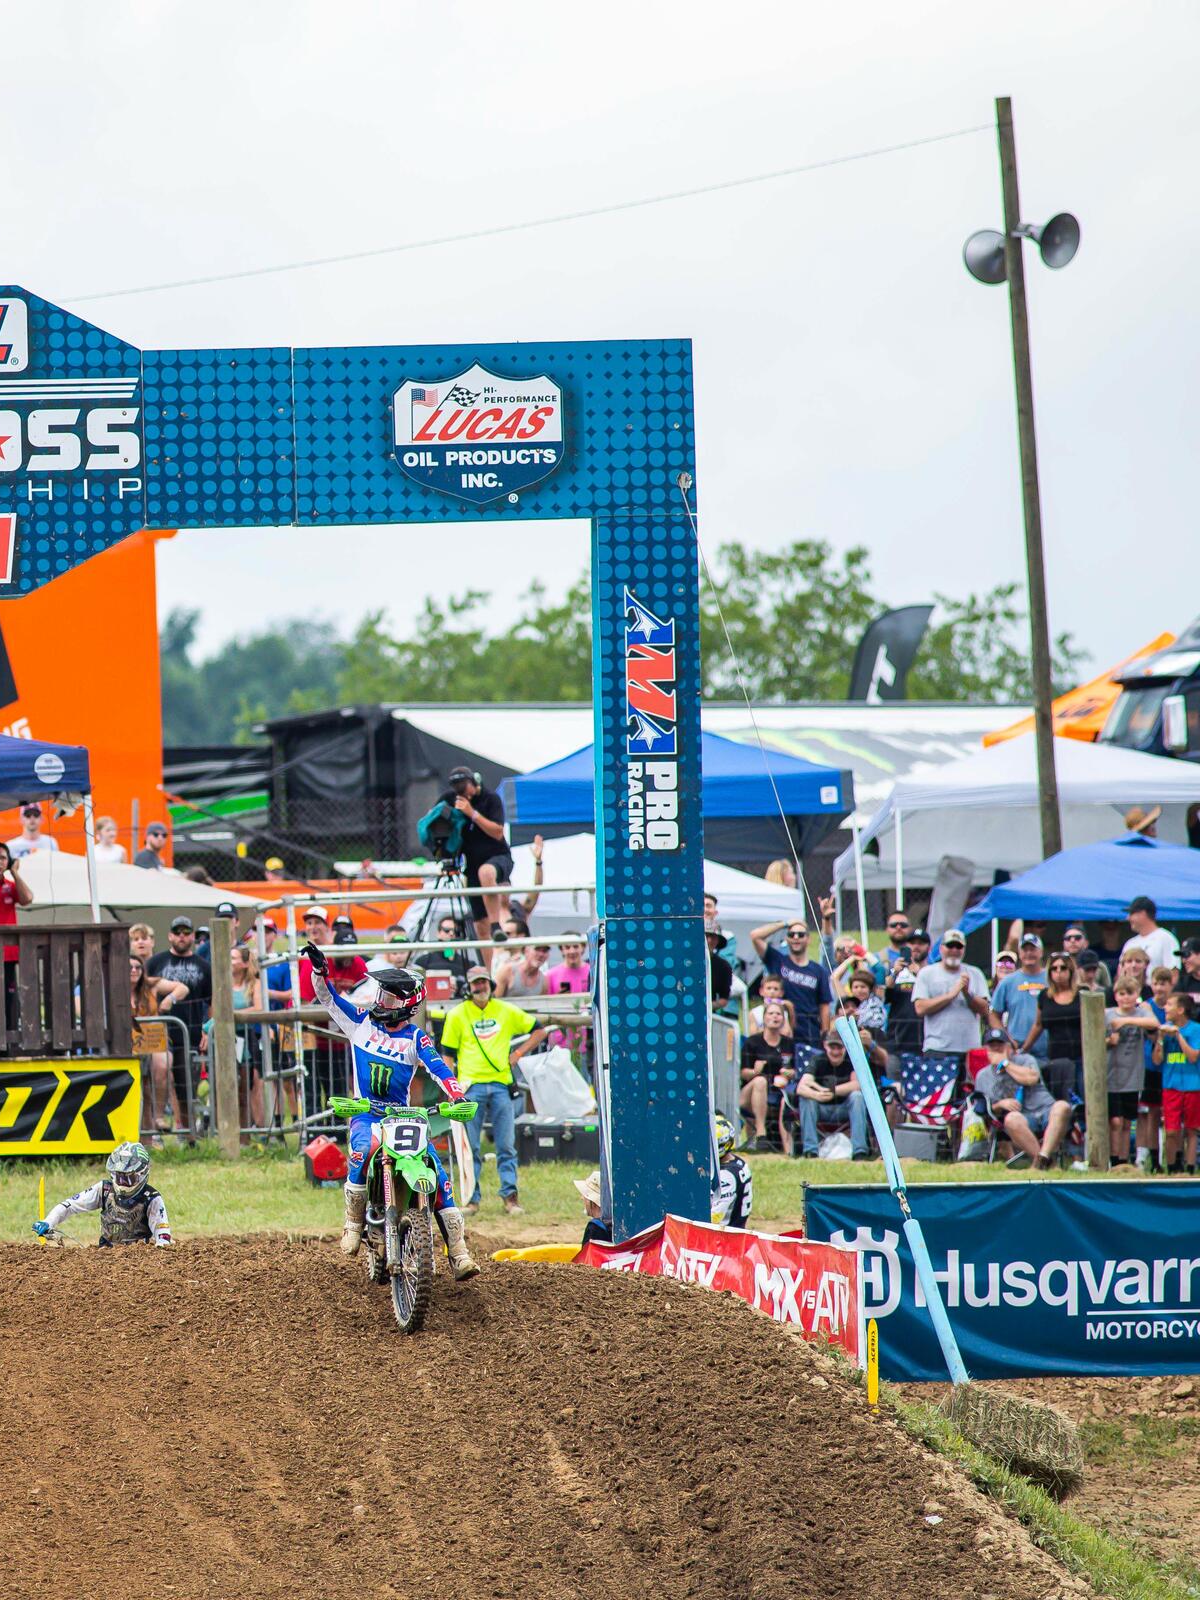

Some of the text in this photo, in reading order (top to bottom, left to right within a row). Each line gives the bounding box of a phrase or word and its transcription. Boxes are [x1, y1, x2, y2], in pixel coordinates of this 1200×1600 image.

[483, 386, 498, 395] HI-
[484, 394, 558, 404] PERFORMANCE
[412, 406, 555, 442] LUCAS
[403, 448, 557, 468] OIL PRODUCTS
[461, 473, 503, 489] INC.
[626, 761, 646, 851] RACING
[644, 761, 680, 851] PRO
[364, 1031, 411, 1062] FOX
[394, 1124, 421, 1152] 9
[750, 1262, 803, 1332] MX
[1086, 1319, 1200, 1340] MOTORCY
